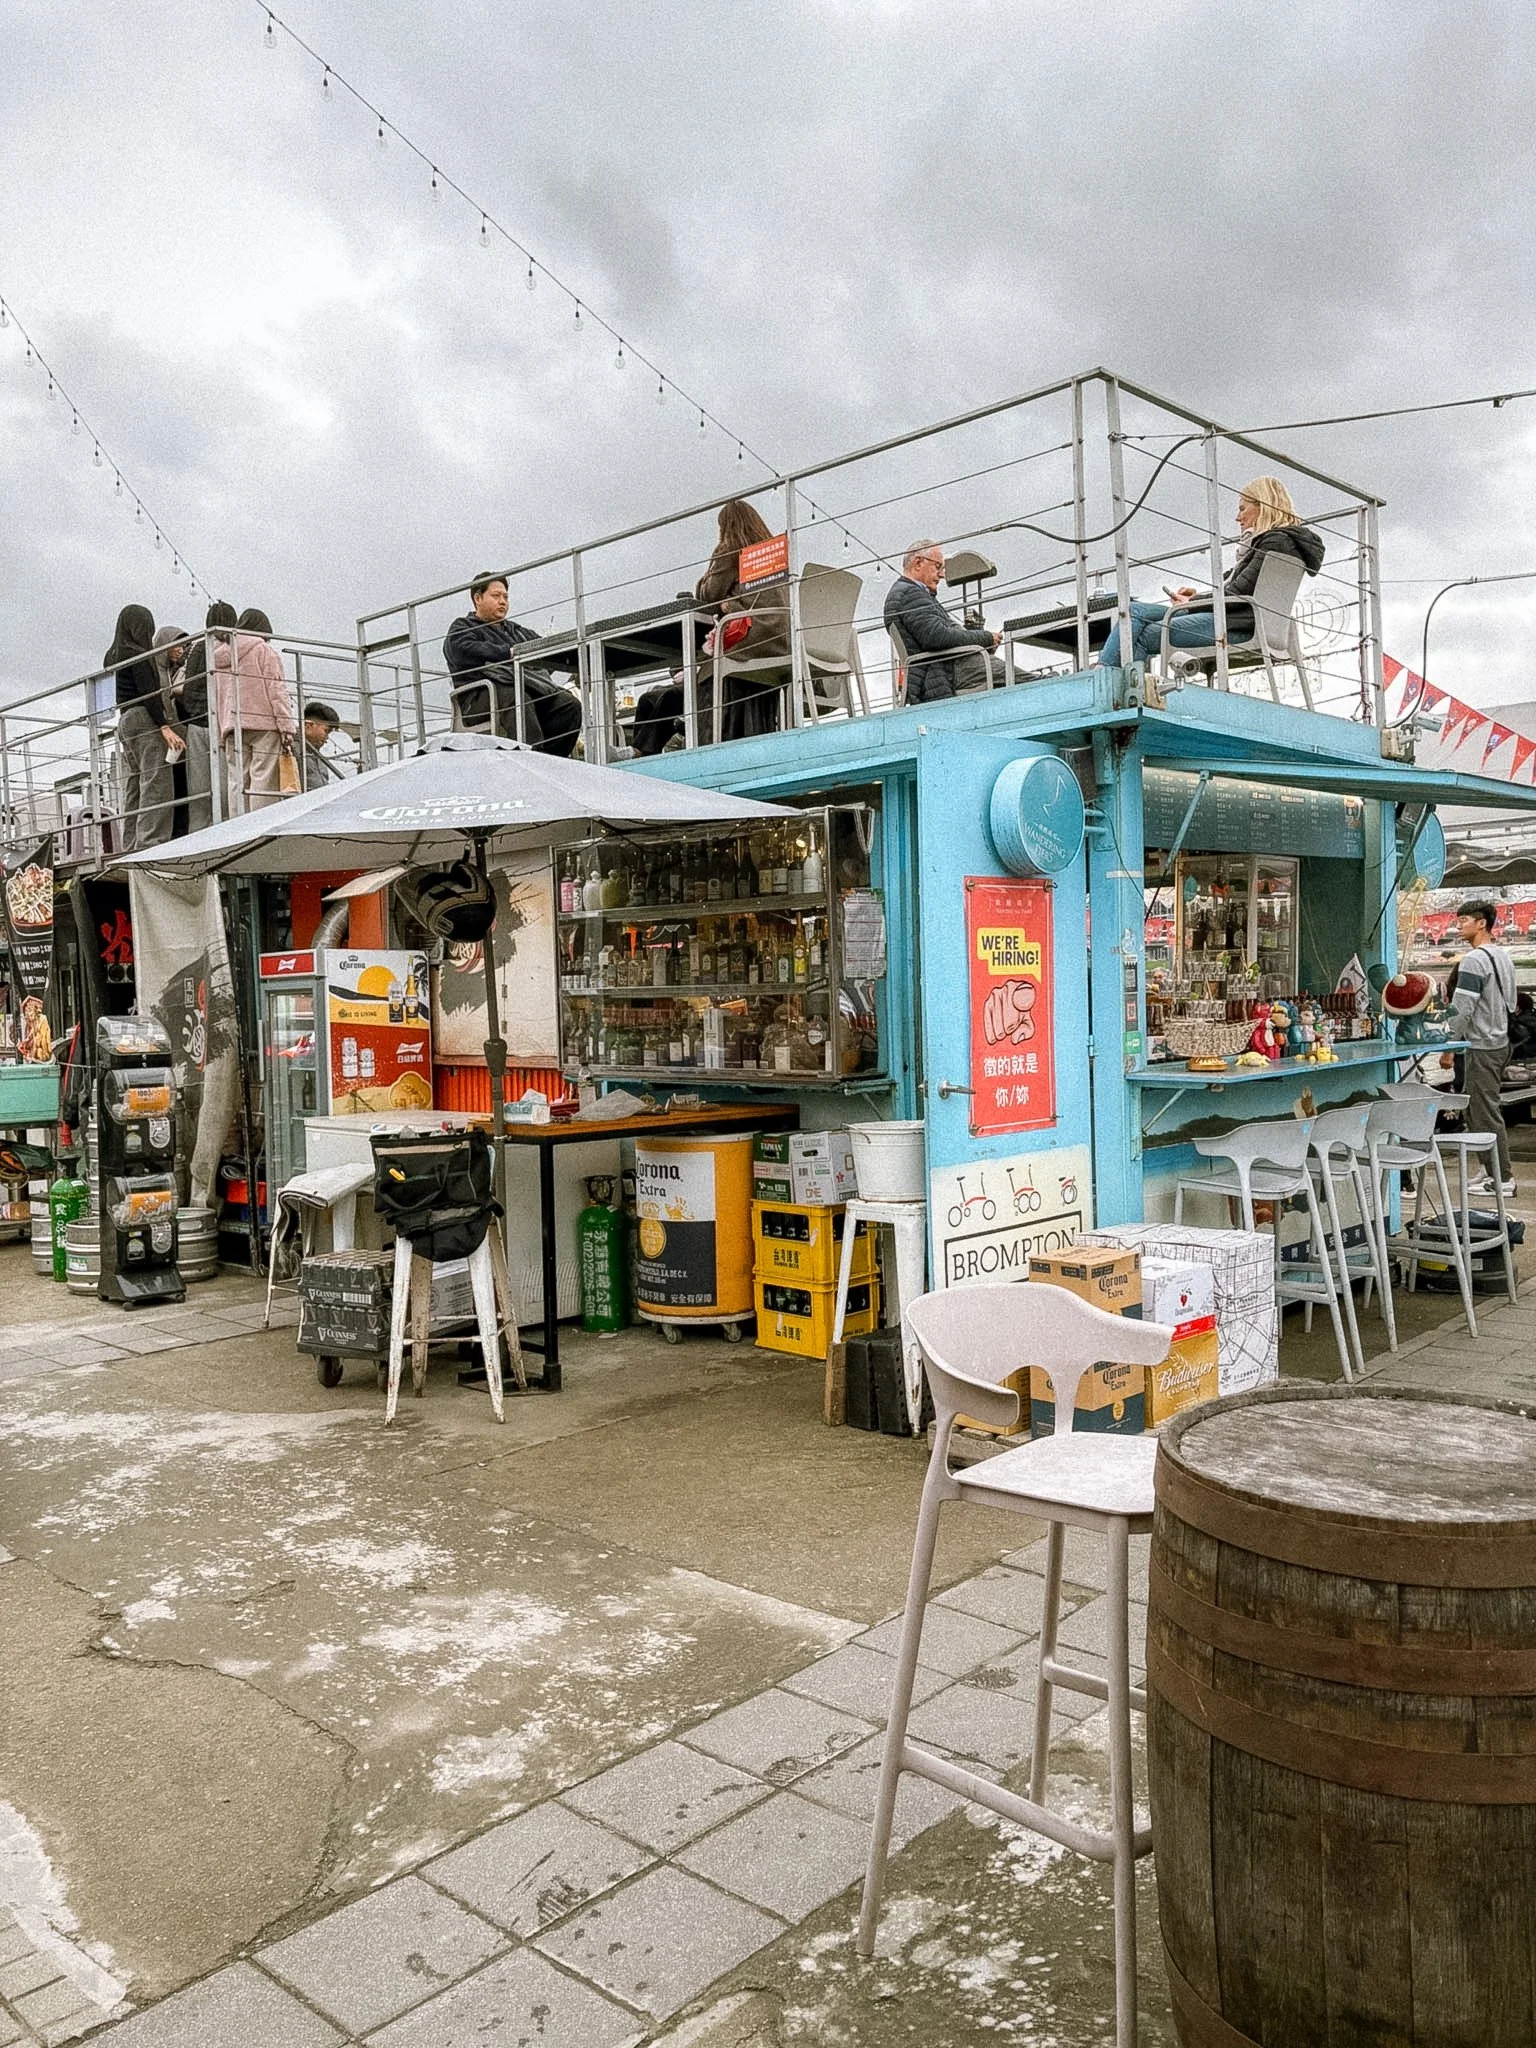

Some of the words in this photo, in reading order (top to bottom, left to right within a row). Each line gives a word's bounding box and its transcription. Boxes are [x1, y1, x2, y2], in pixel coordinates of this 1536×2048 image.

[358, 799, 525, 821] Corona
[982, 935, 1019, 950] WE'RE
[339, 960, 366, 970] Corona
[992, 950, 1039, 967] HIRING!
[983, 1052, 1039, 1078] 徵的就是
[995, 1084, 1030, 1108] 你/妳
[639, 1179, 667, 1198] Extra
[952, 1226, 1077, 1282] BROMPTON
[1098, 1273, 1129, 1292] Corona
[1102, 1364, 1131, 1385] Corona
[1157, 1360, 1216, 1394] Budweiser
